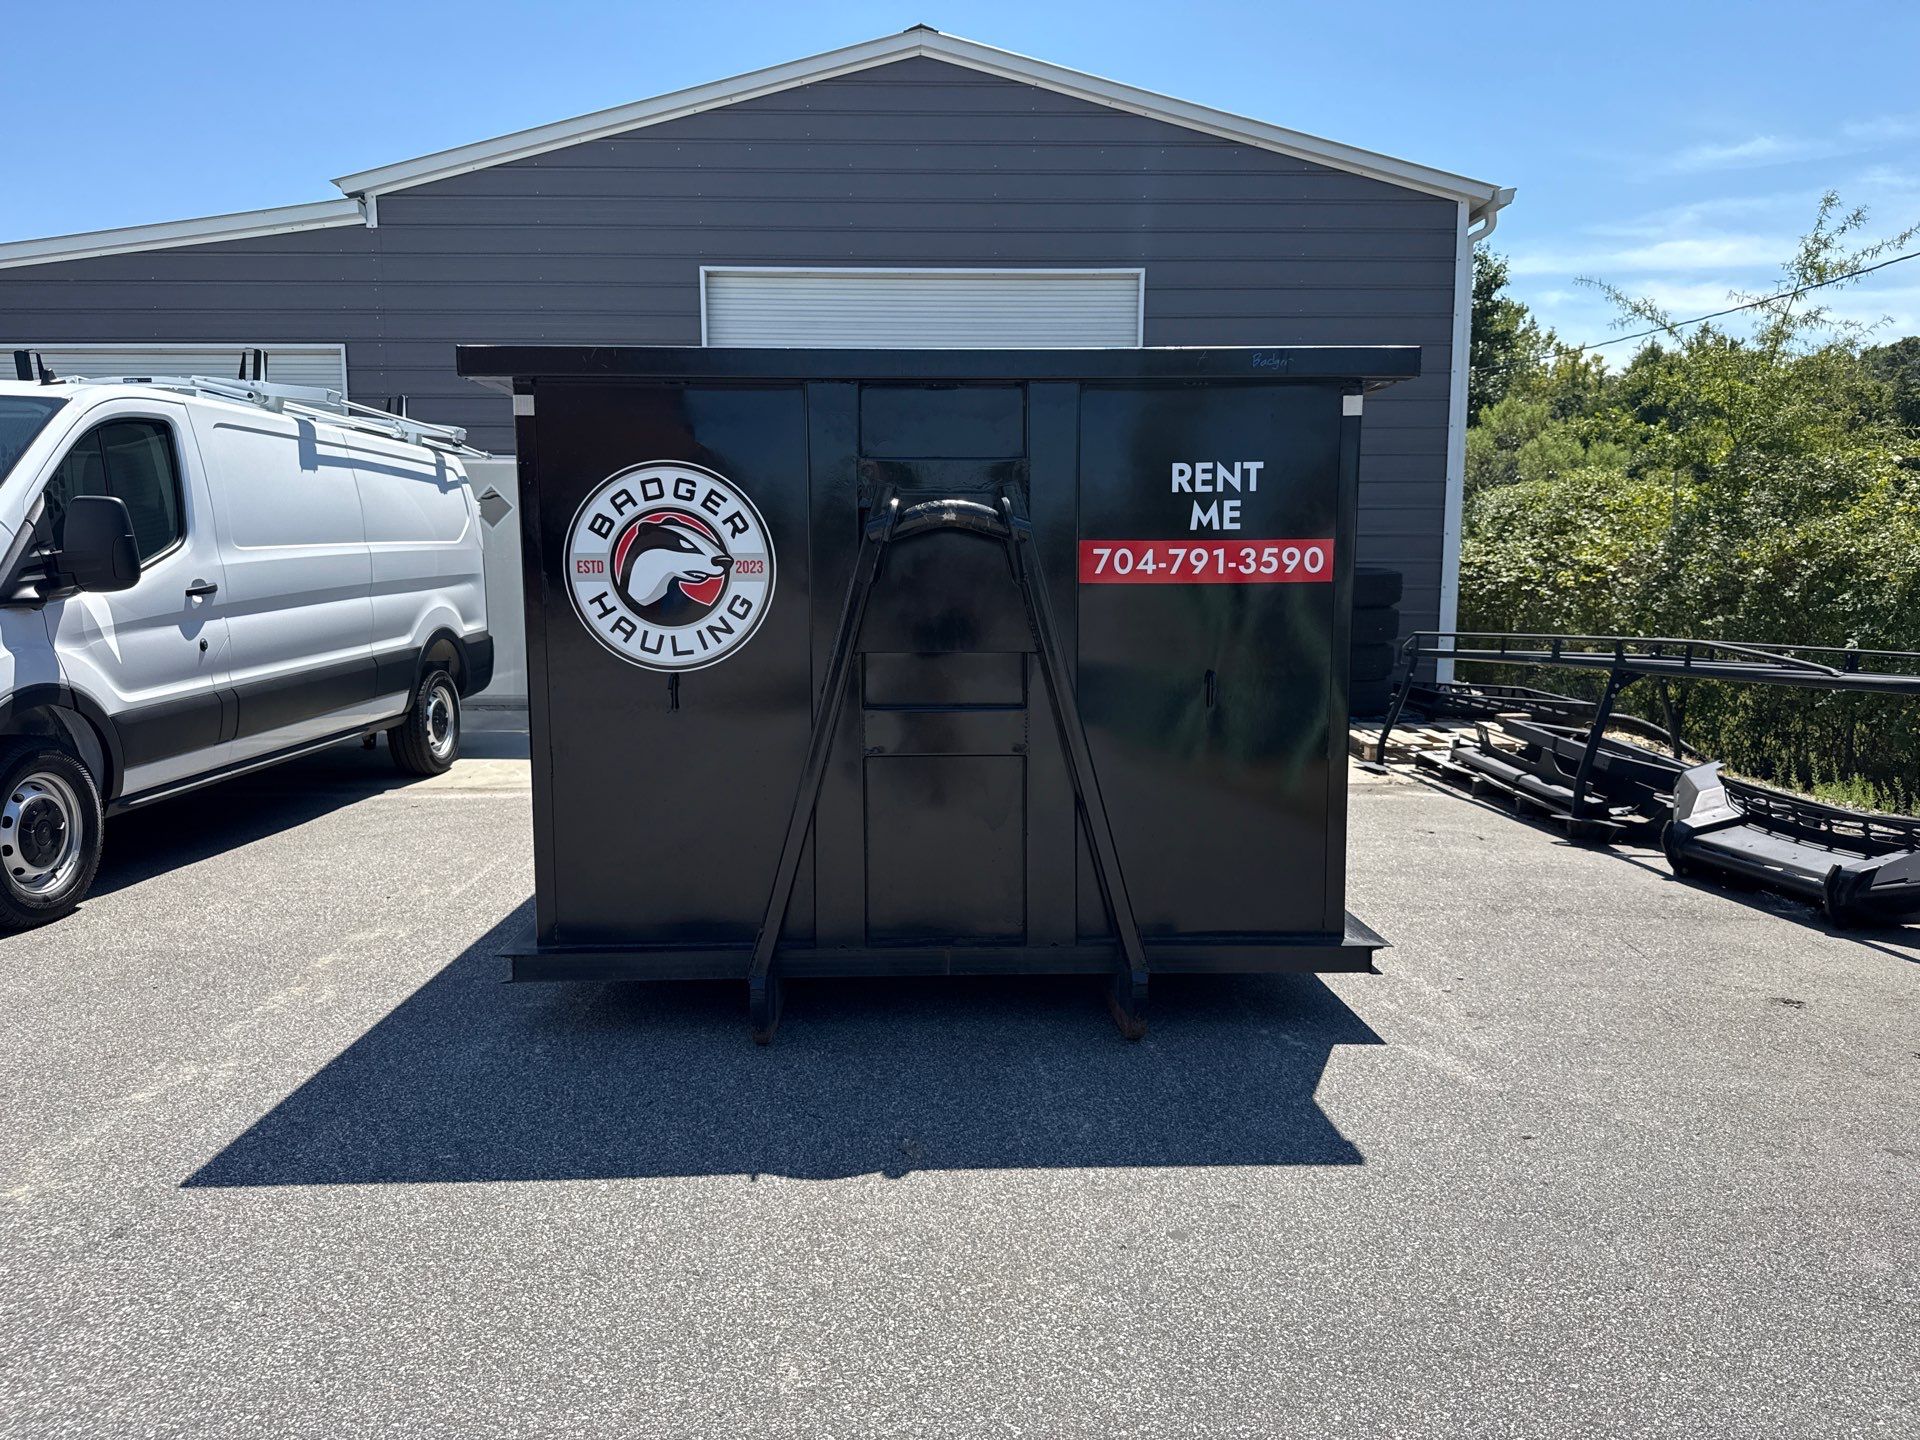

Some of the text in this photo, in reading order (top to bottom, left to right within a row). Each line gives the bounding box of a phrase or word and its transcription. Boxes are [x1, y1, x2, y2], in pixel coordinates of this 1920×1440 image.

[1171, 461, 1264, 493] RENT
[587, 477, 750, 540] BADGER
[1189, 500, 1241, 531] ME
[576, 559, 604, 574] ESTD
[735, 560, 764, 574] 2023
[1092, 546, 1325, 575] 704-791-3590
[588, 591, 753, 657] HAULING
